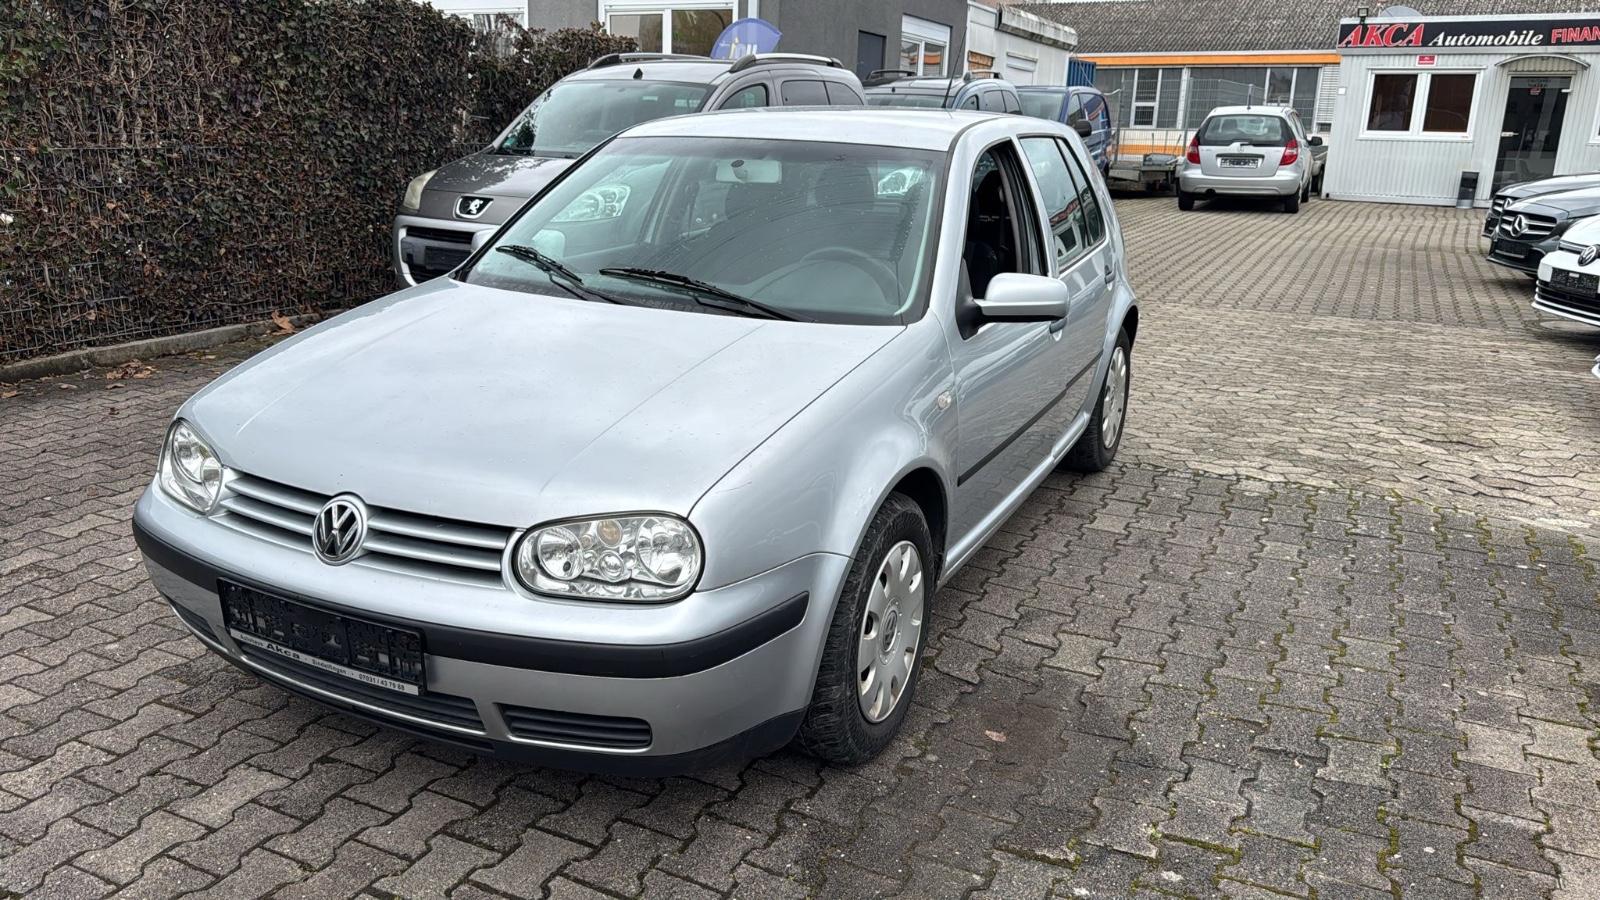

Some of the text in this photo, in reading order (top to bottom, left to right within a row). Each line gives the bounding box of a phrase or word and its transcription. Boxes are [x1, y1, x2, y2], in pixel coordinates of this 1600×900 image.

[1338, 23, 1600, 48] AKCA Automobile FINAN
[316, 498, 363, 561] VW
[267, 643, 300, 659] Akca
[358, 673, 376, 684] 07031
